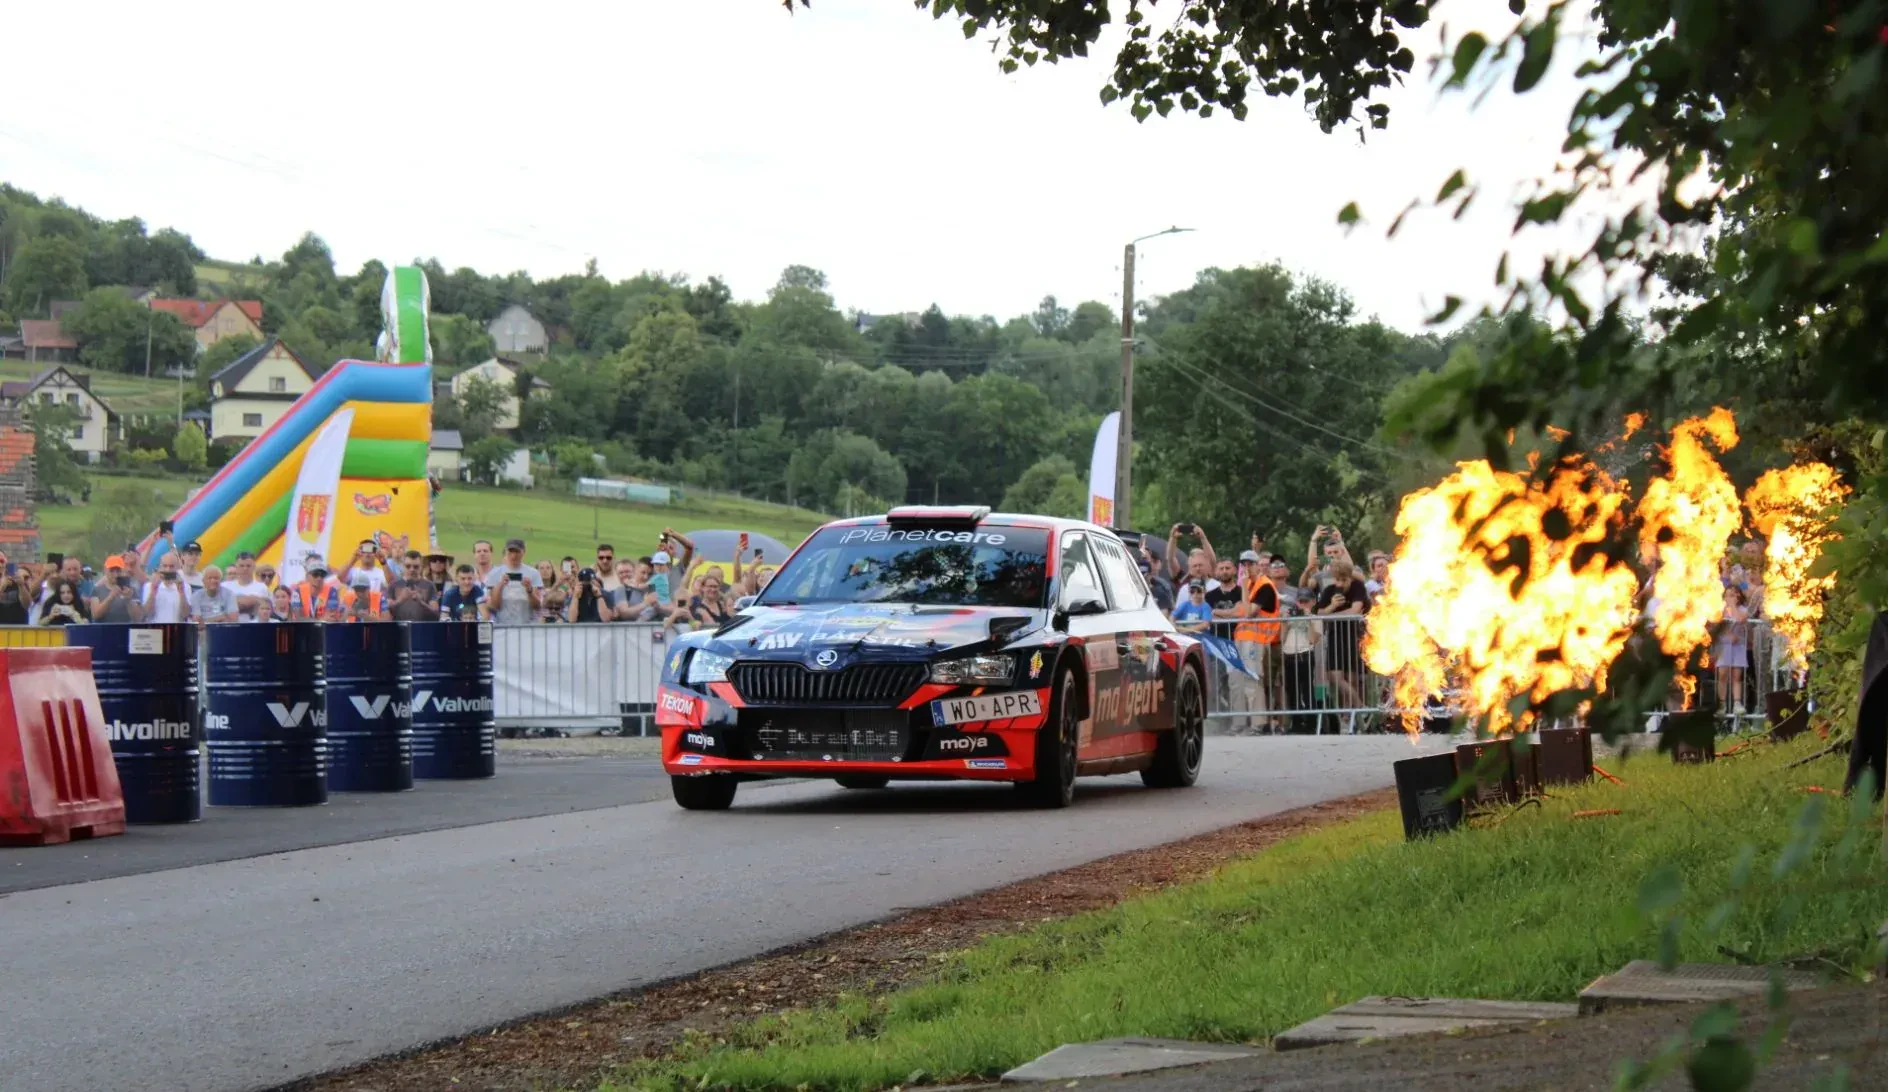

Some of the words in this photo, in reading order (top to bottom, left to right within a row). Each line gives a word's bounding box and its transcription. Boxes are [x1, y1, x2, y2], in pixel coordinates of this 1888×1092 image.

[839, 528, 1006, 545] iPlanetcare
[432, 696, 494, 713] Valvolin
[660, 693, 695, 715] TEKOM
[950, 700, 977, 721] WO
[992, 694, 1032, 717] APR
[309, 709, 327, 727] Val
[104, 718, 191, 741] alvoline
[686, 731, 715, 751] moya
[940, 735, 989, 753] moya
